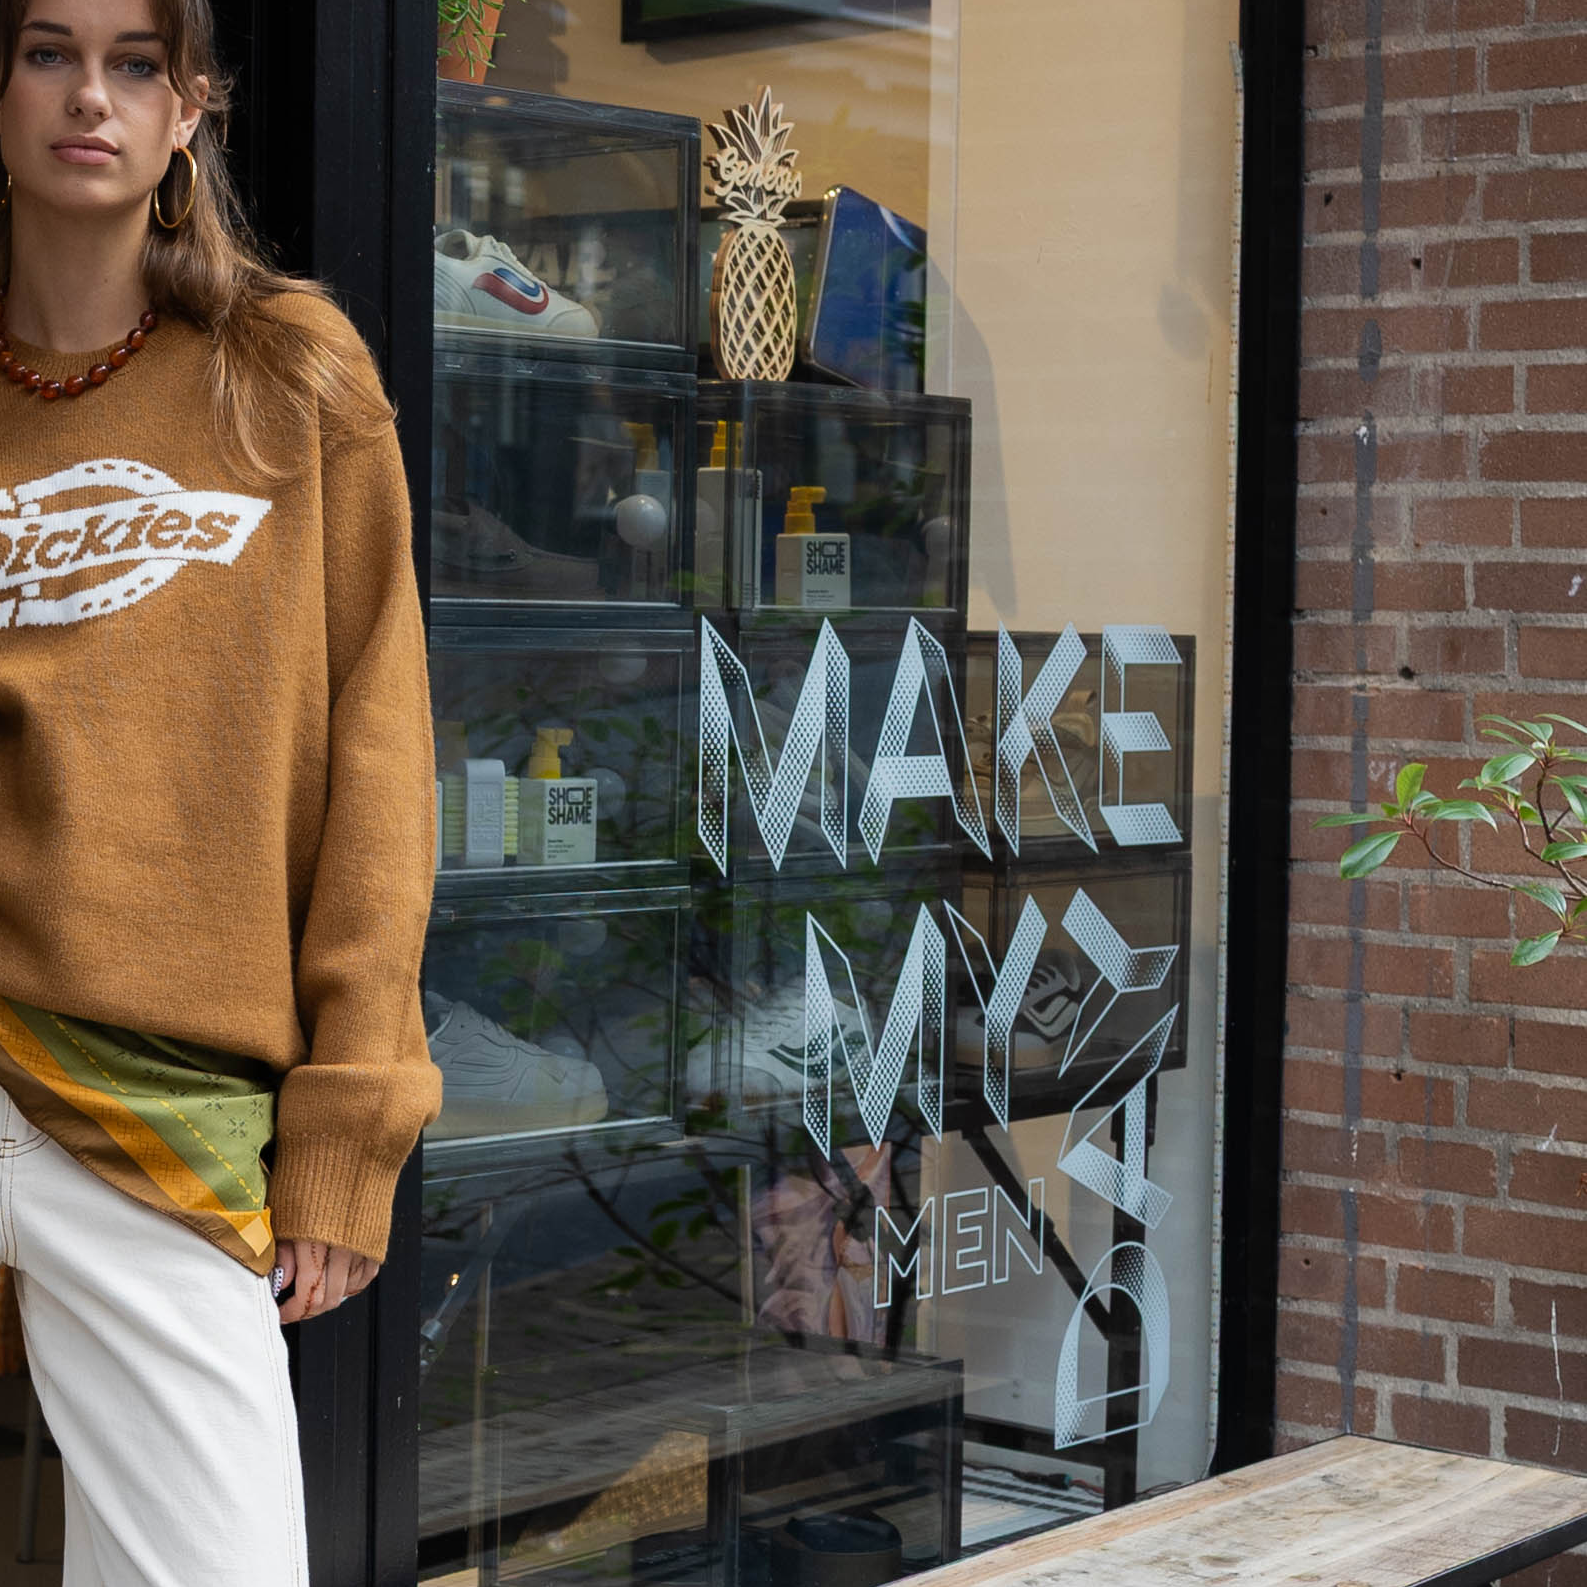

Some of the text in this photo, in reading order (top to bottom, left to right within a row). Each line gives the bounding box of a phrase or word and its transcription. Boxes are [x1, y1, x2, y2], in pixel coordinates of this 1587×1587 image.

[806, 541, 846, 558] SHOE
[806, 558, 846, 575] SHAME
[697, 614, 1183, 878] MAKE
[548, 787, 593, 806] SHOE
[548, 806, 593, 825] SHAME
[802, 893, 1047, 1163] MY
[873, 1177, 1045, 1310] MEN
